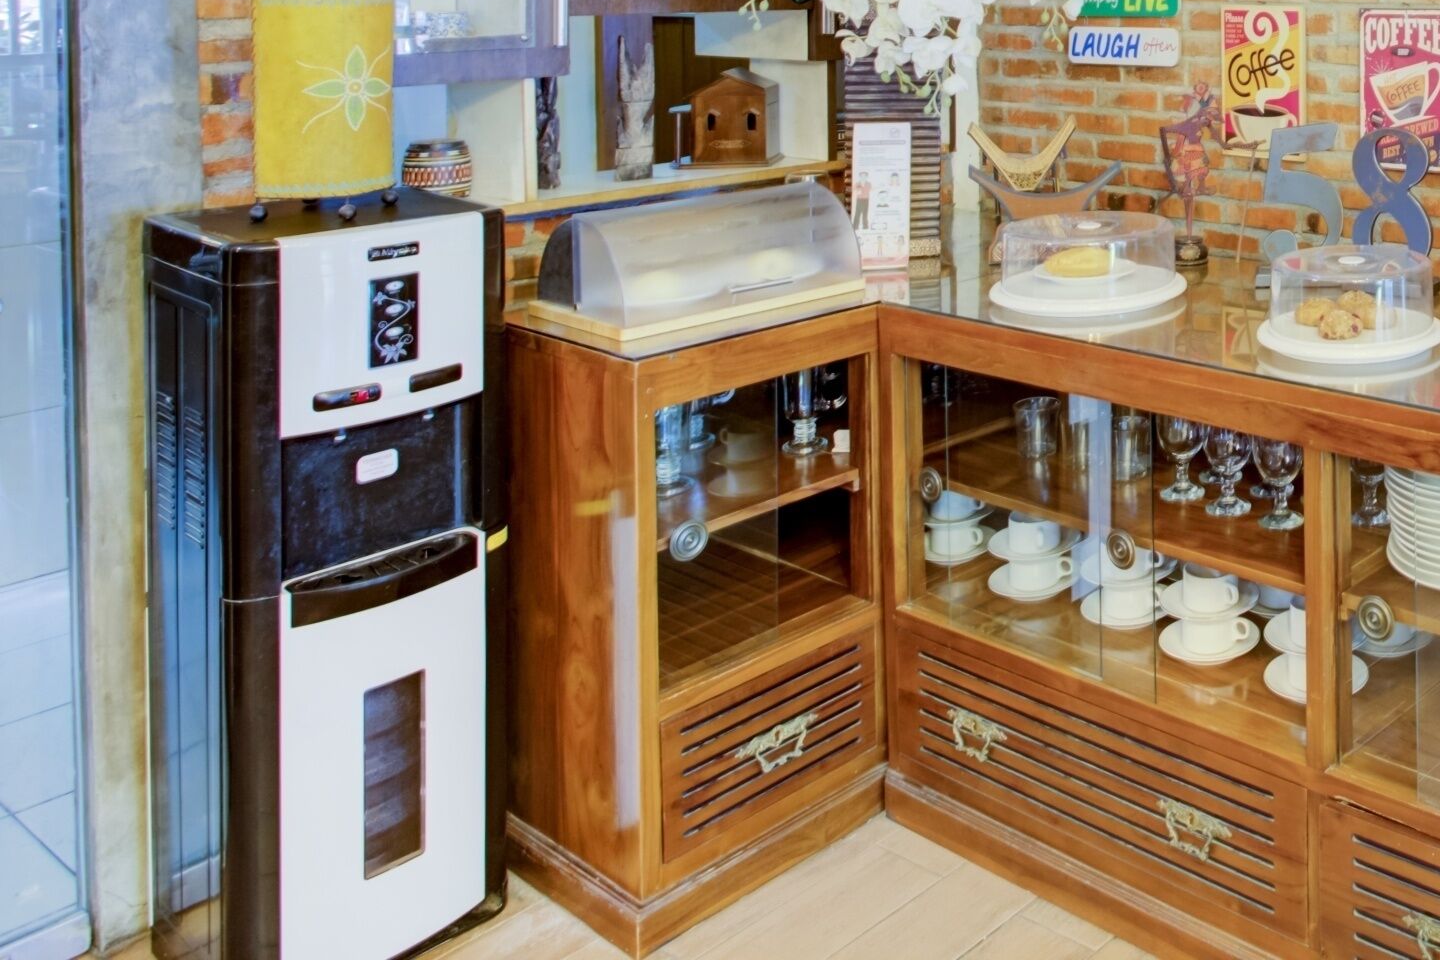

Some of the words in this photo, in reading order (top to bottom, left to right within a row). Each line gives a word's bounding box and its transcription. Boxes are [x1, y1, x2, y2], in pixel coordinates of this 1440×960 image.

[1071, 31, 1141, 59] LAUGH
[1143, 37, 1177, 57] often
[1228, 48, 1295, 98] Coffee
